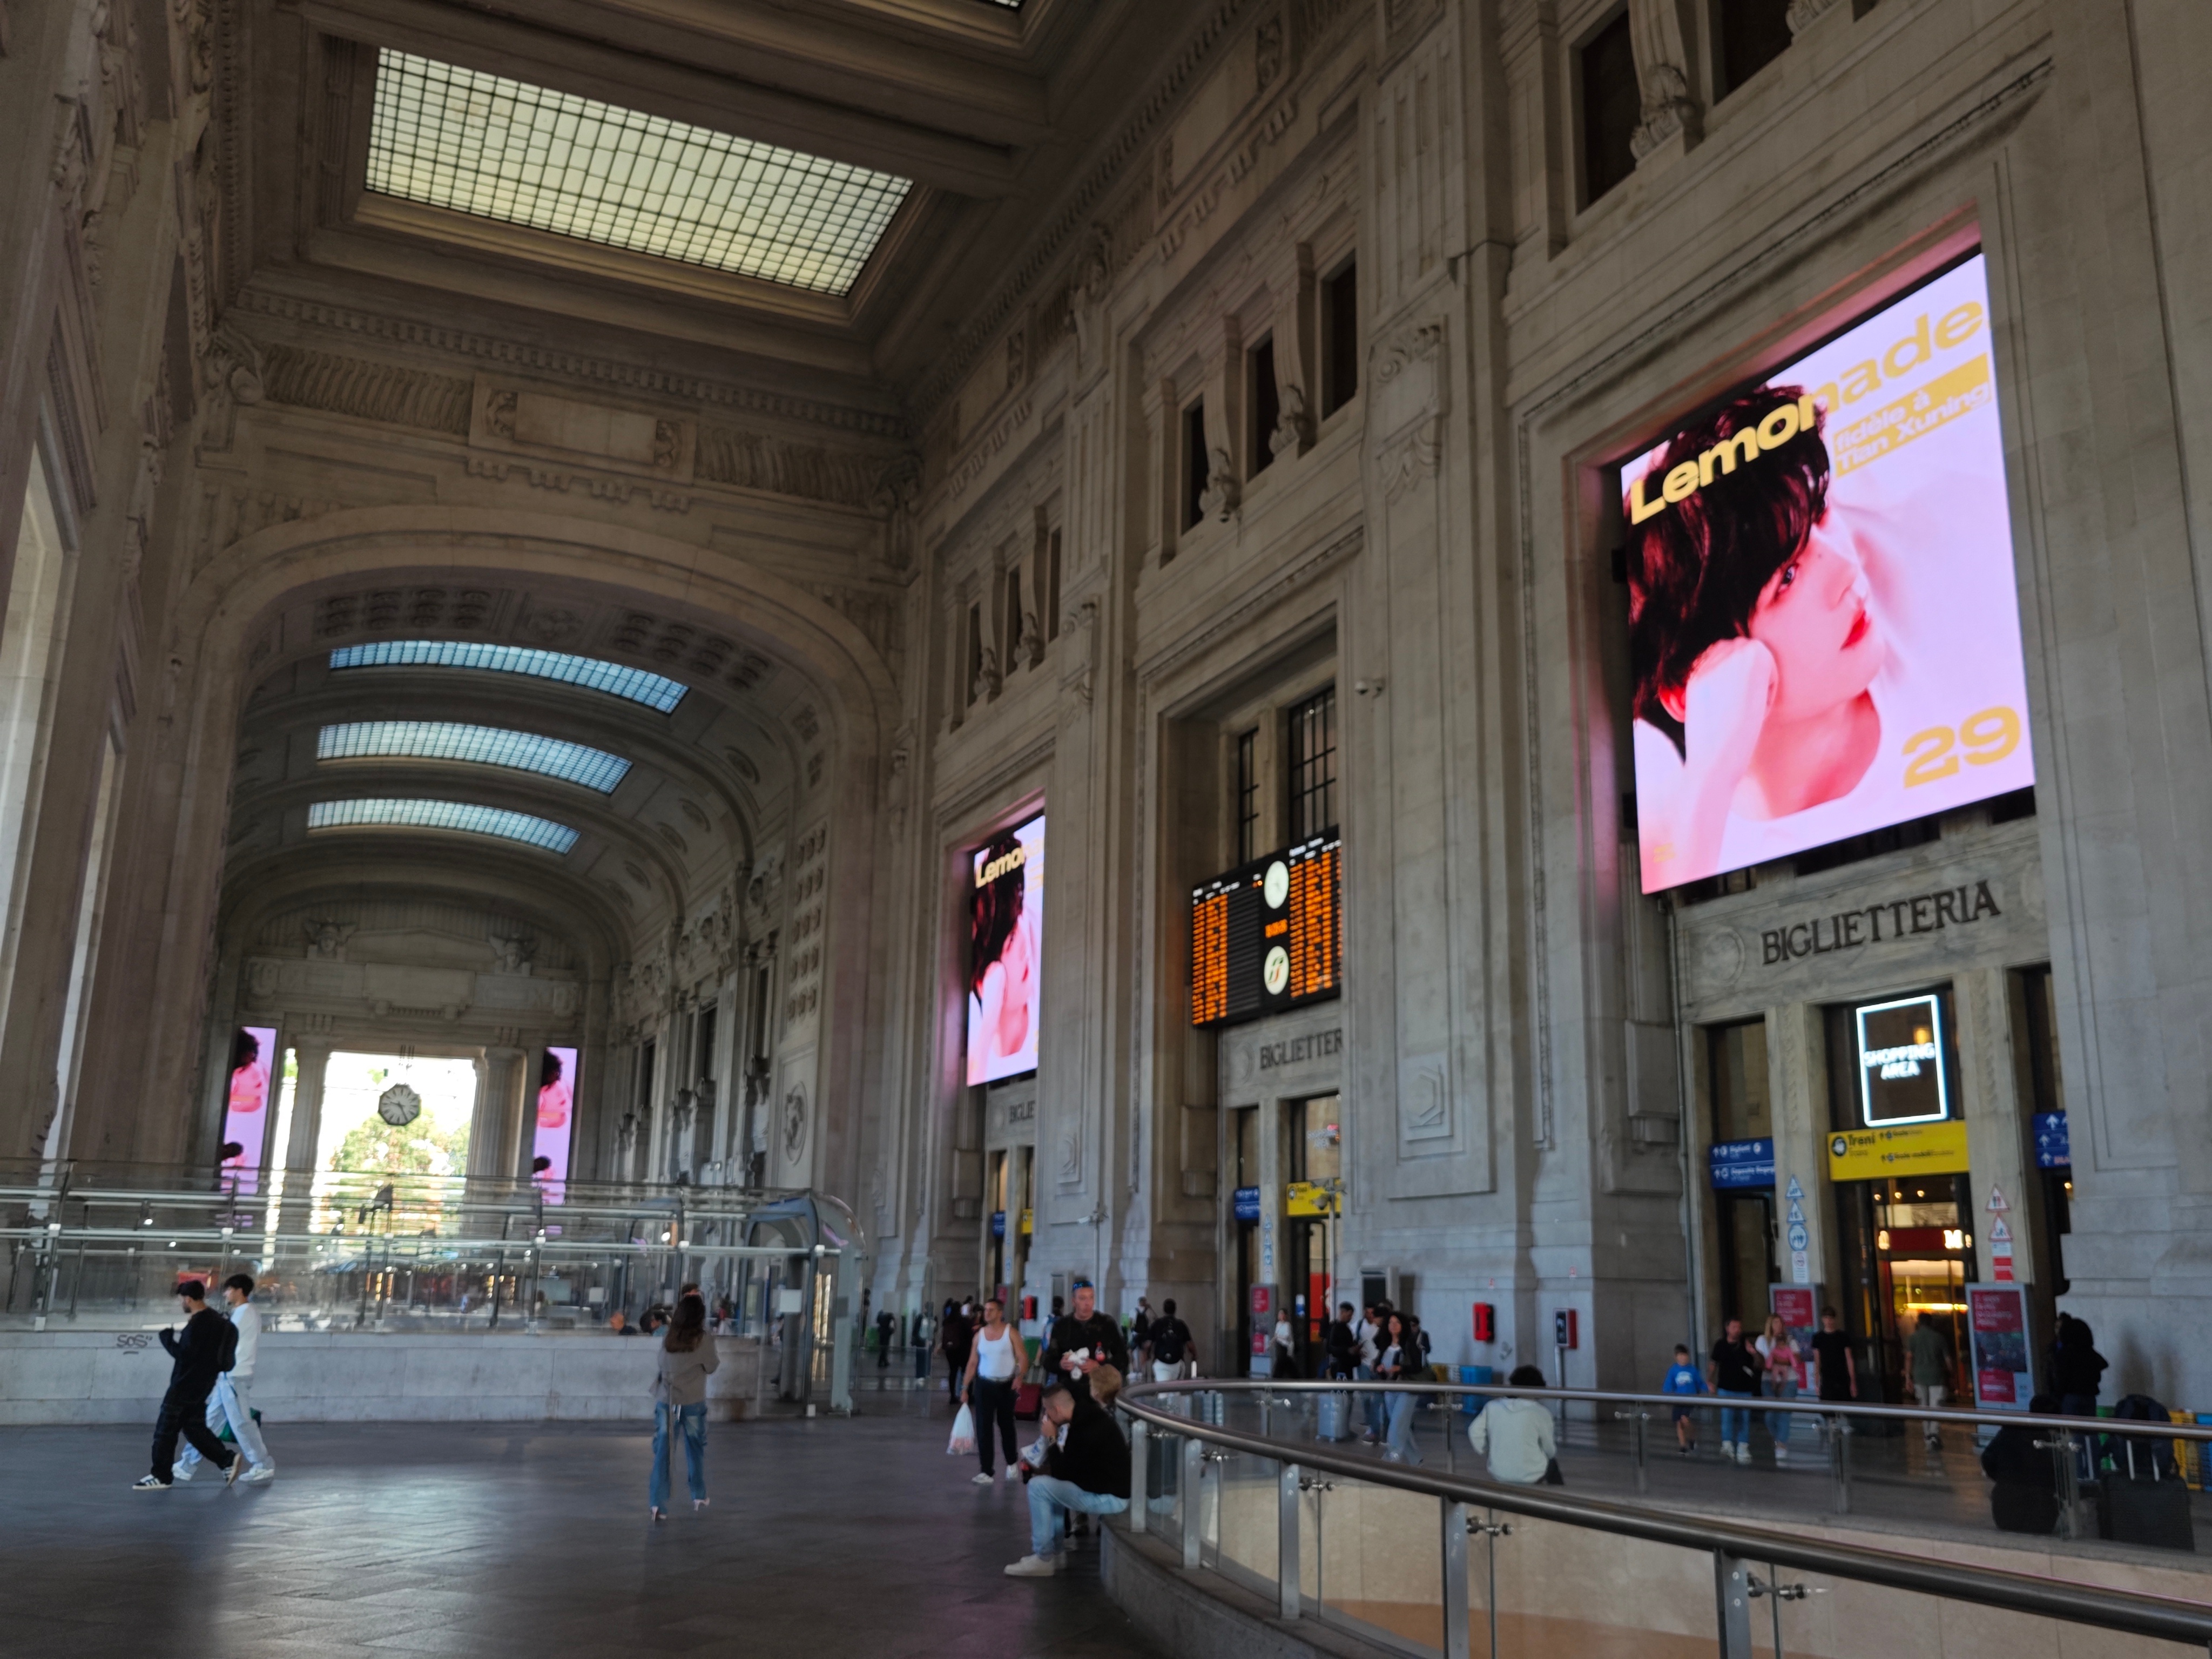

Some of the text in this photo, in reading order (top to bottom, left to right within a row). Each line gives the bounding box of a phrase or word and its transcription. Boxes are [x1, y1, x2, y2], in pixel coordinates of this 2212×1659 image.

[1629, 300, 1984, 525] Lemonade
[1836, 436, 1889, 470] Tian
[1901, 705, 2020, 790] 29
[1761, 880, 2002, 966] BIGLIETTERIA
[1863, 1042, 1936, 1068] SHOPPING
[1880, 1060, 1921, 1080] AREA
